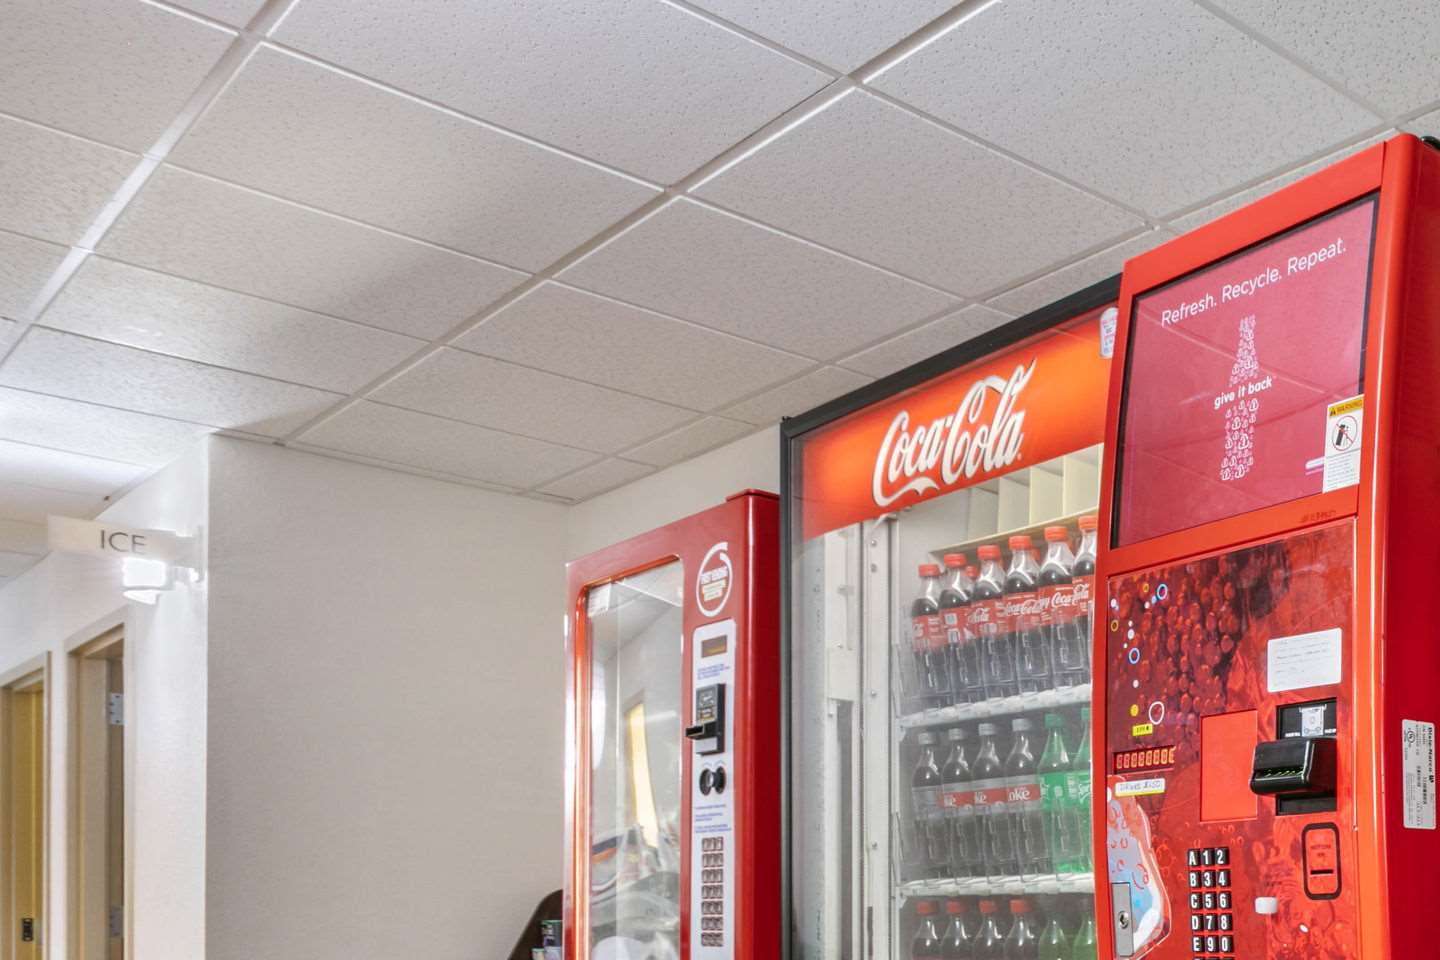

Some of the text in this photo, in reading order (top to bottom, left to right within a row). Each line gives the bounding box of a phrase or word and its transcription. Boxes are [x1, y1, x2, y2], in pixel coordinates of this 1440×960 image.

[1161, 237, 1346, 327] Refresh. Recycle. Repeat.
[1214, 375, 1272, 410] give it back
[872, 356, 1036, 507] Coca-Cola
[101, 530, 145, 555] ICE
[1008, 786, 1031, 801] oke
[1189, 849, 1224, 865] A 1 2
[1190, 871, 1225, 887] B 3 4
[1191, 893, 1226, 908] C 5 6
[1192, 915, 1227, 930] D 7 8
[1193, 937, 1228, 951] E 9 0
